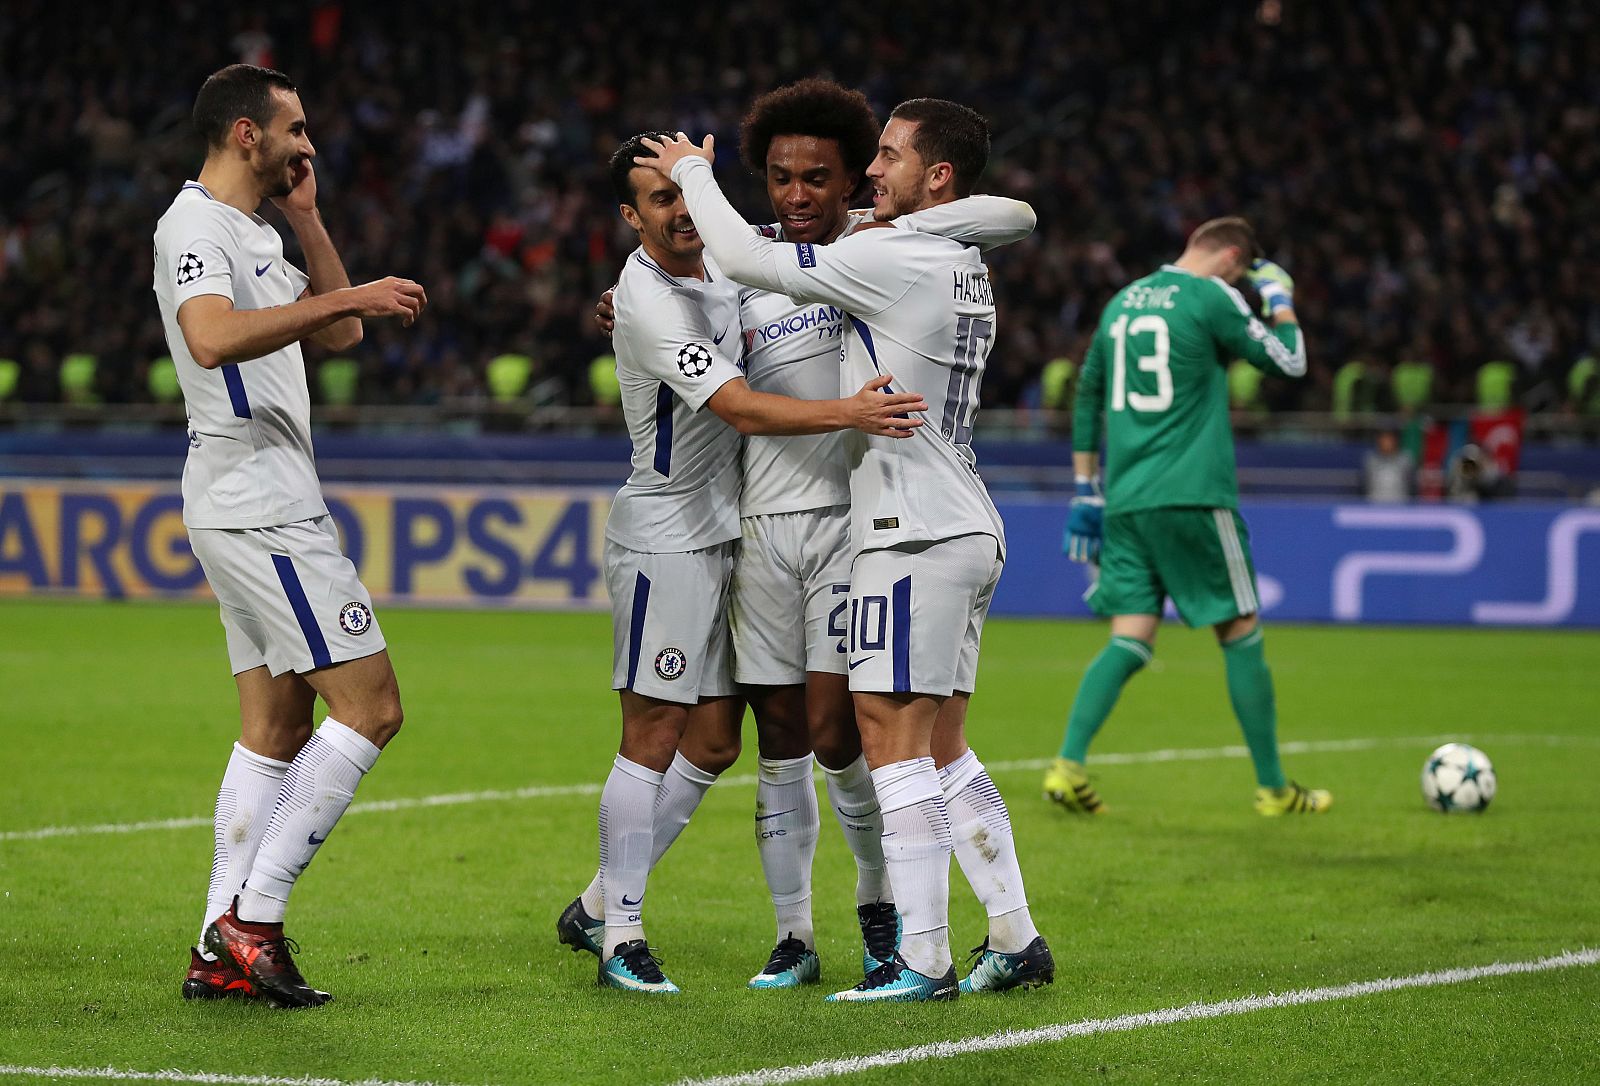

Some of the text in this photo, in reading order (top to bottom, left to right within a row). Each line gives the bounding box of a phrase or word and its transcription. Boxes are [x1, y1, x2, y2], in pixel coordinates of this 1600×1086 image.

[941, 317, 991, 445] 10
[1110, 313, 1174, 412] 13
[391, 499, 600, 597] PS4
[342, 603, 362, 614] CHELSEA
[850, 595, 888, 653] 10
[662, 648, 683, 657] CHELSEA
[761, 829, 787, 839] CFC
